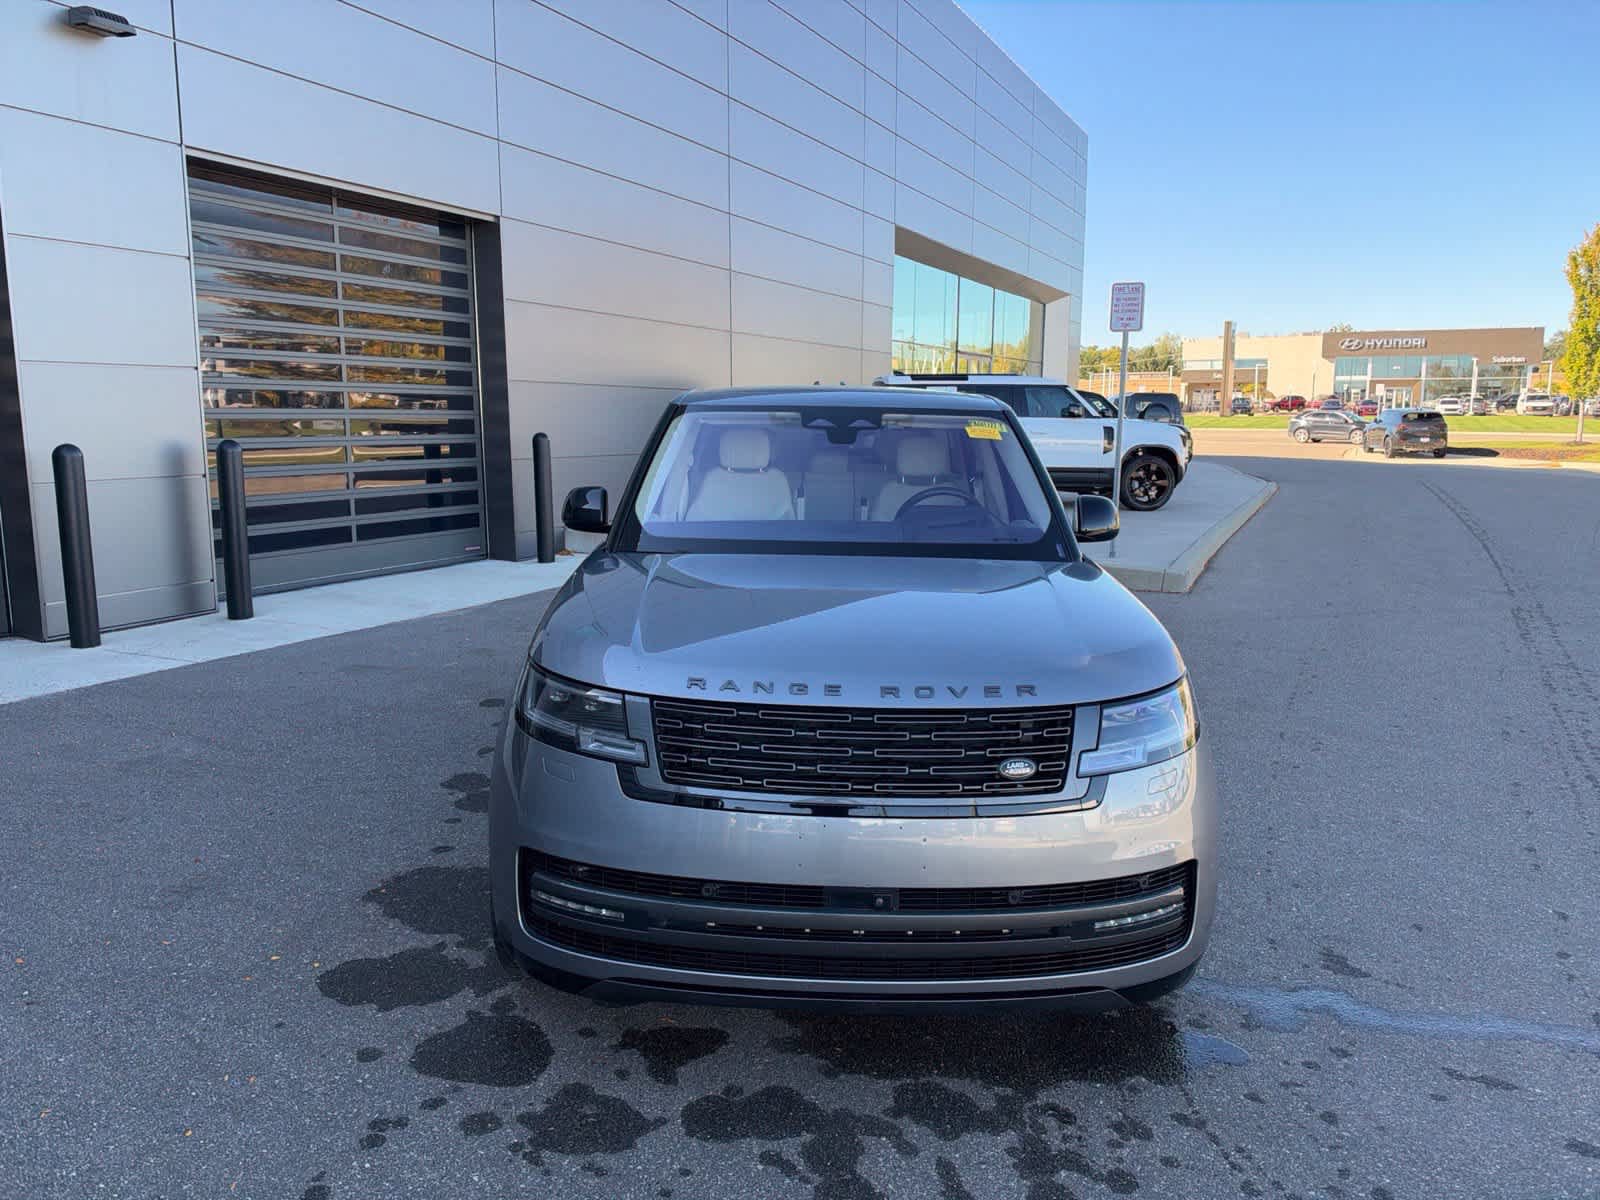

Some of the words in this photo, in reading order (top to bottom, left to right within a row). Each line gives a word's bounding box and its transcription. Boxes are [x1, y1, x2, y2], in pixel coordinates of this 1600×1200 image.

[1365, 337, 1427, 349] HYUNDAI
[686, 676, 843, 697] RANGE
[880, 684, 1038, 699] ROVER
